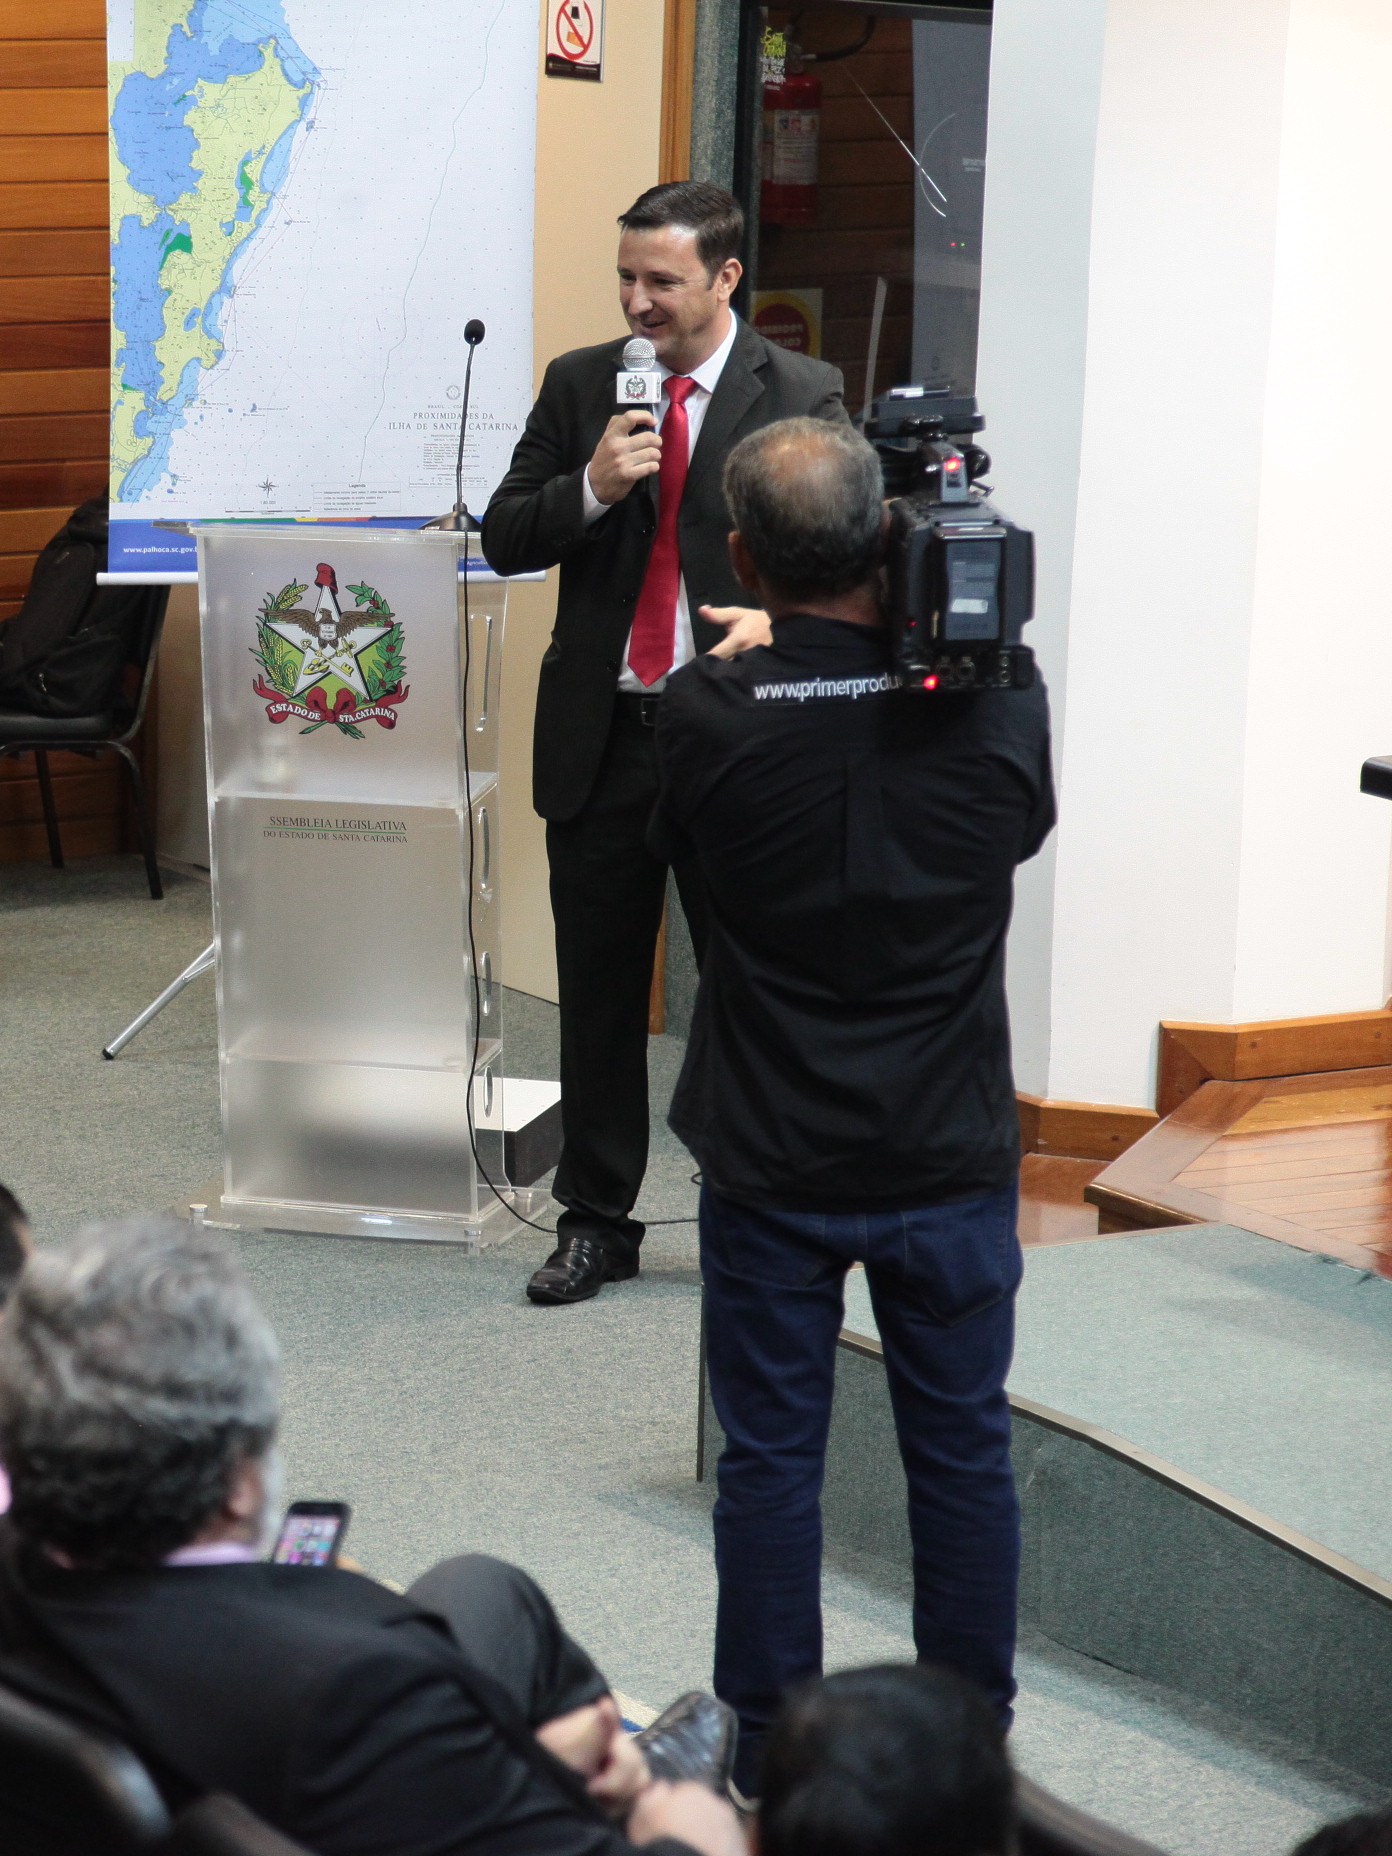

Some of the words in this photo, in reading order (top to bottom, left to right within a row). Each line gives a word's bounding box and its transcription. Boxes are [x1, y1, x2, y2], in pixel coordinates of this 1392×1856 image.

[482, 412, 494, 420] DA
[388, 422, 412, 430] ILHA
[416, 422, 428, 430] DE
[468, 422, 519, 431] CATARINA
[270, 703, 308, 716] ESTADO
[308, 711, 321, 720] DE
[269, 816, 332, 828] SSEMBLEIA
[334, 819, 407, 831] LEGISLATIVA
[263, 830, 276, 838] DO
[279, 831, 315, 840] ESTADO
[317, 832, 329, 840] DE
[332, 833, 361, 842] SANTA
[363, 835, 408, 843] CATARINA
